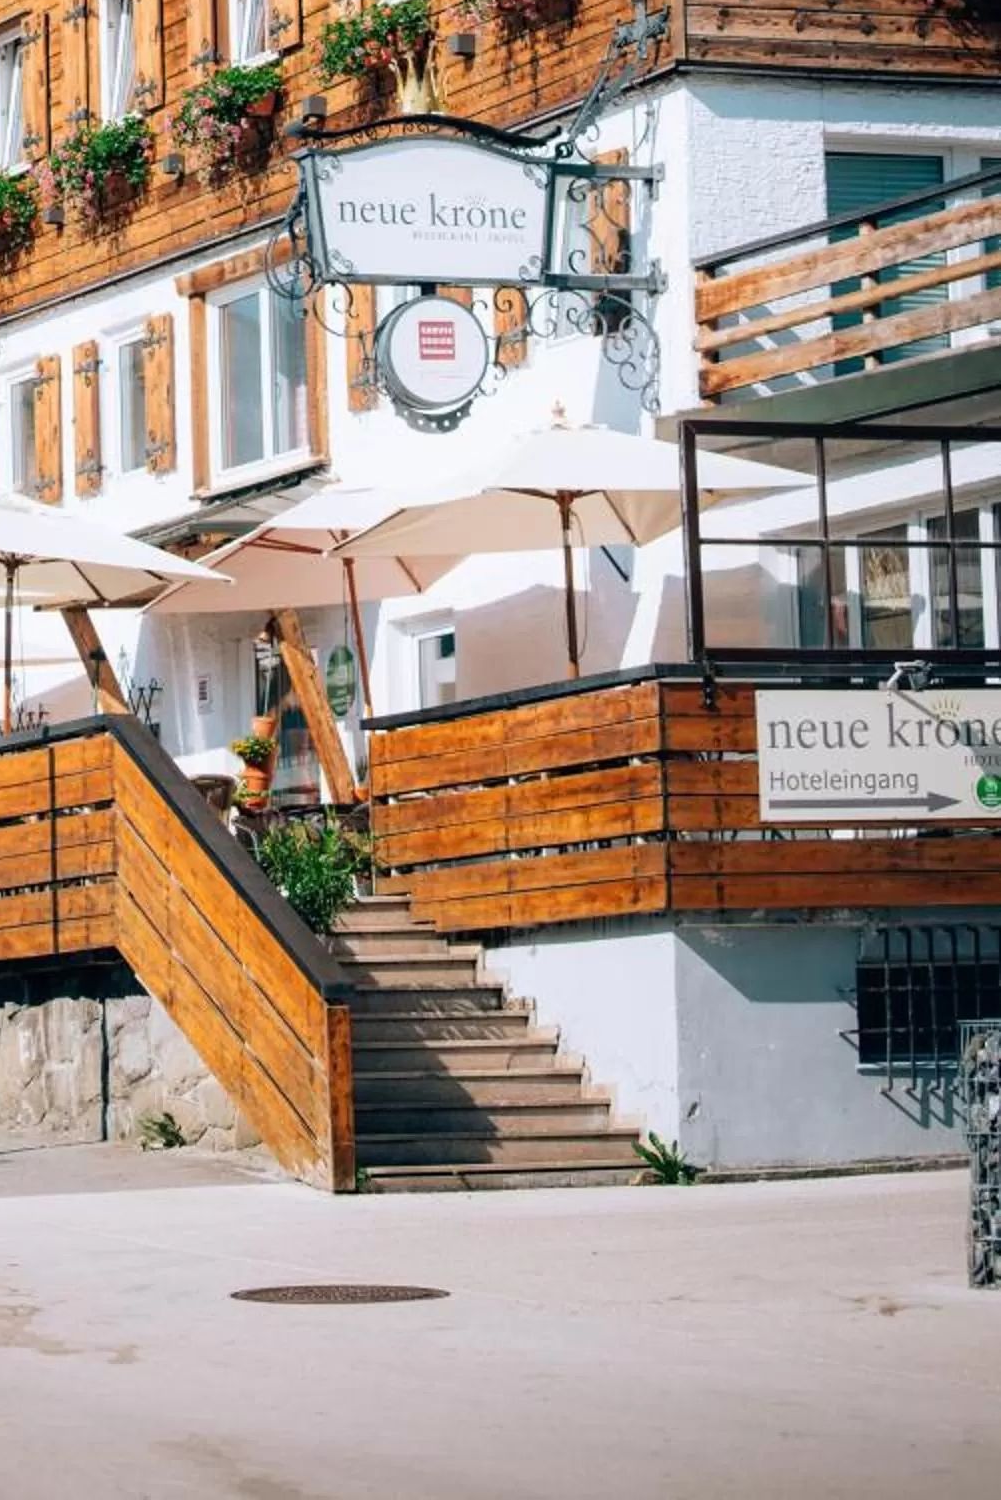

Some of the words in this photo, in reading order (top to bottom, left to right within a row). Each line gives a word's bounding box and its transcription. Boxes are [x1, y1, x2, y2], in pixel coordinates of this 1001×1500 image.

[339, 200, 416, 225] neue
[767, 719, 870, 749] neue
[768, 768, 919, 795] Hoteleingang
